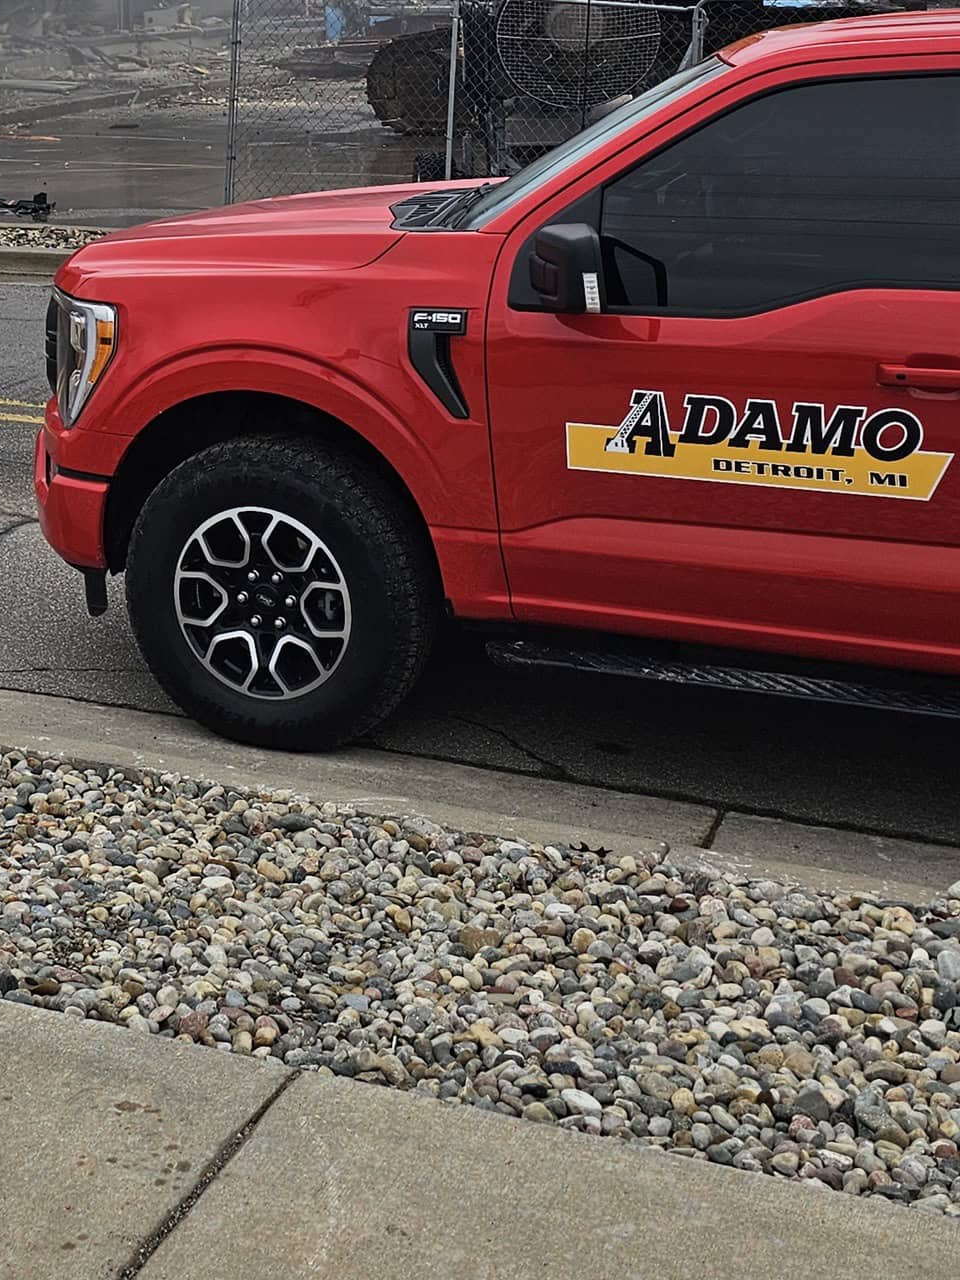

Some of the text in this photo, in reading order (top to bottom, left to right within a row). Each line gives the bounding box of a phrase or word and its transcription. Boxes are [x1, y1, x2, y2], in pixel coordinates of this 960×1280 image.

[413, 312, 461, 324] F-150
[604, 389, 924, 462] ADAMO
[711, 458, 909, 488] DETROIT, MI
